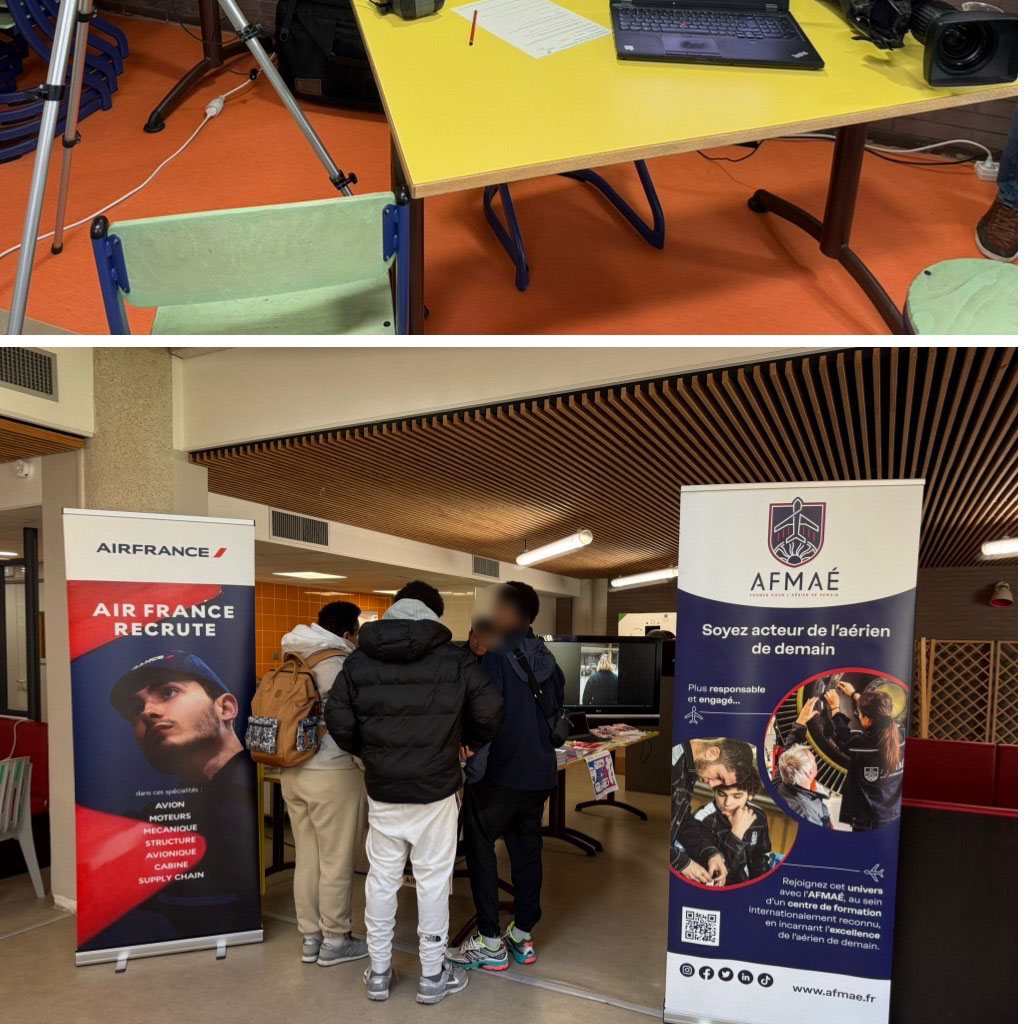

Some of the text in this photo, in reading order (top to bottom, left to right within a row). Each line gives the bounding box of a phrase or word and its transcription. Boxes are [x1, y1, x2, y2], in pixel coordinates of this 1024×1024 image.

[96, 542, 209, 558] AIRFRANCE
[750, 567, 840, 591] AFMAÉ
[92, 603, 235, 619] AIR FRANCE
[114, 622, 216, 637] RECRUTE
[702, 623, 890, 640] Soyez acteur de l'aérien
[751, 642, 835, 656] de demain
[688, 683, 766, 695] Plus responsable
[688, 695, 697, 703] et
[135, 789, 151, 797] dans
[165, 787, 199, 796] spécialités
[155, 801, 185, 810] AVION
[149, 812, 191, 822] MOTEURS
[143, 824, 198, 835] MECANIQUE
[145, 836, 196, 847] STRUCTURE
[146, 848, 196, 859] AVIONIQUE
[154, 861, 188, 871] CABINE
[138, 871, 204, 885] SUPPLY CHAIN
[782, 877, 883, 895] Rejoignez cet univers
[779, 889, 801, 898] avec
[848, 896, 860, 904] au
[863, 897, 882, 906] sein
[765, 897, 882, 917] d'un centre de formation
[749, 905, 881, 929] internationalement reconnu,
[778, 920, 822, 933] incarnant
[825, 925, 881, 940] l'excellence
[778, 931, 880, 950] de l'aérien de demain.
[792, 984, 876, 1003] www.afmae.fr
